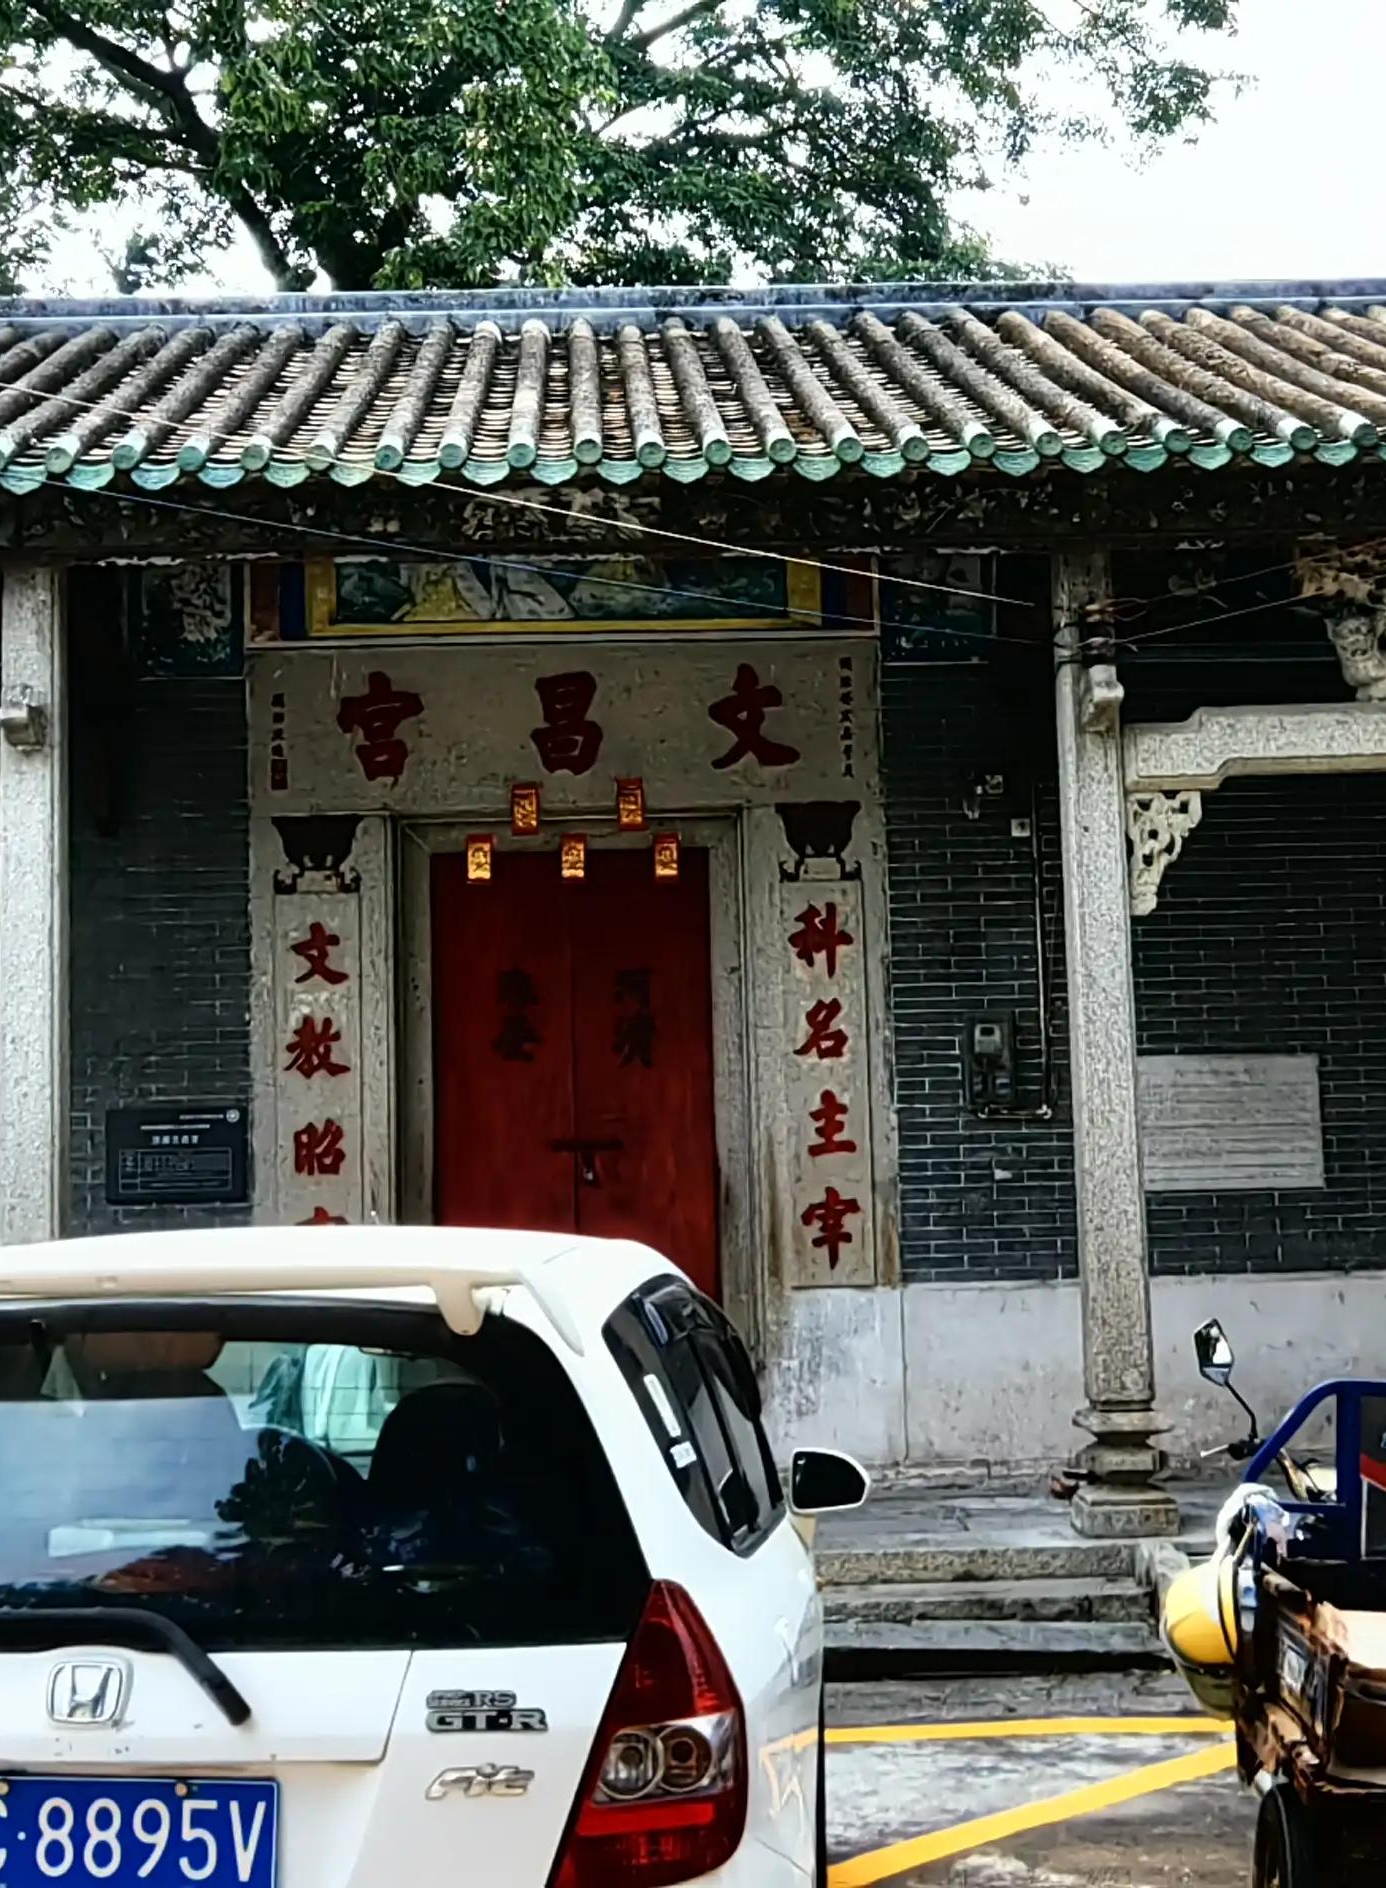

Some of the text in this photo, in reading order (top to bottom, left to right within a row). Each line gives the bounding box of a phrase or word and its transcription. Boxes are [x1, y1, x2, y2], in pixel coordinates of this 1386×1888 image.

[283, 920, 352, 1225] 文教昭
[787, 901, 861, 1271] 科名主宰
